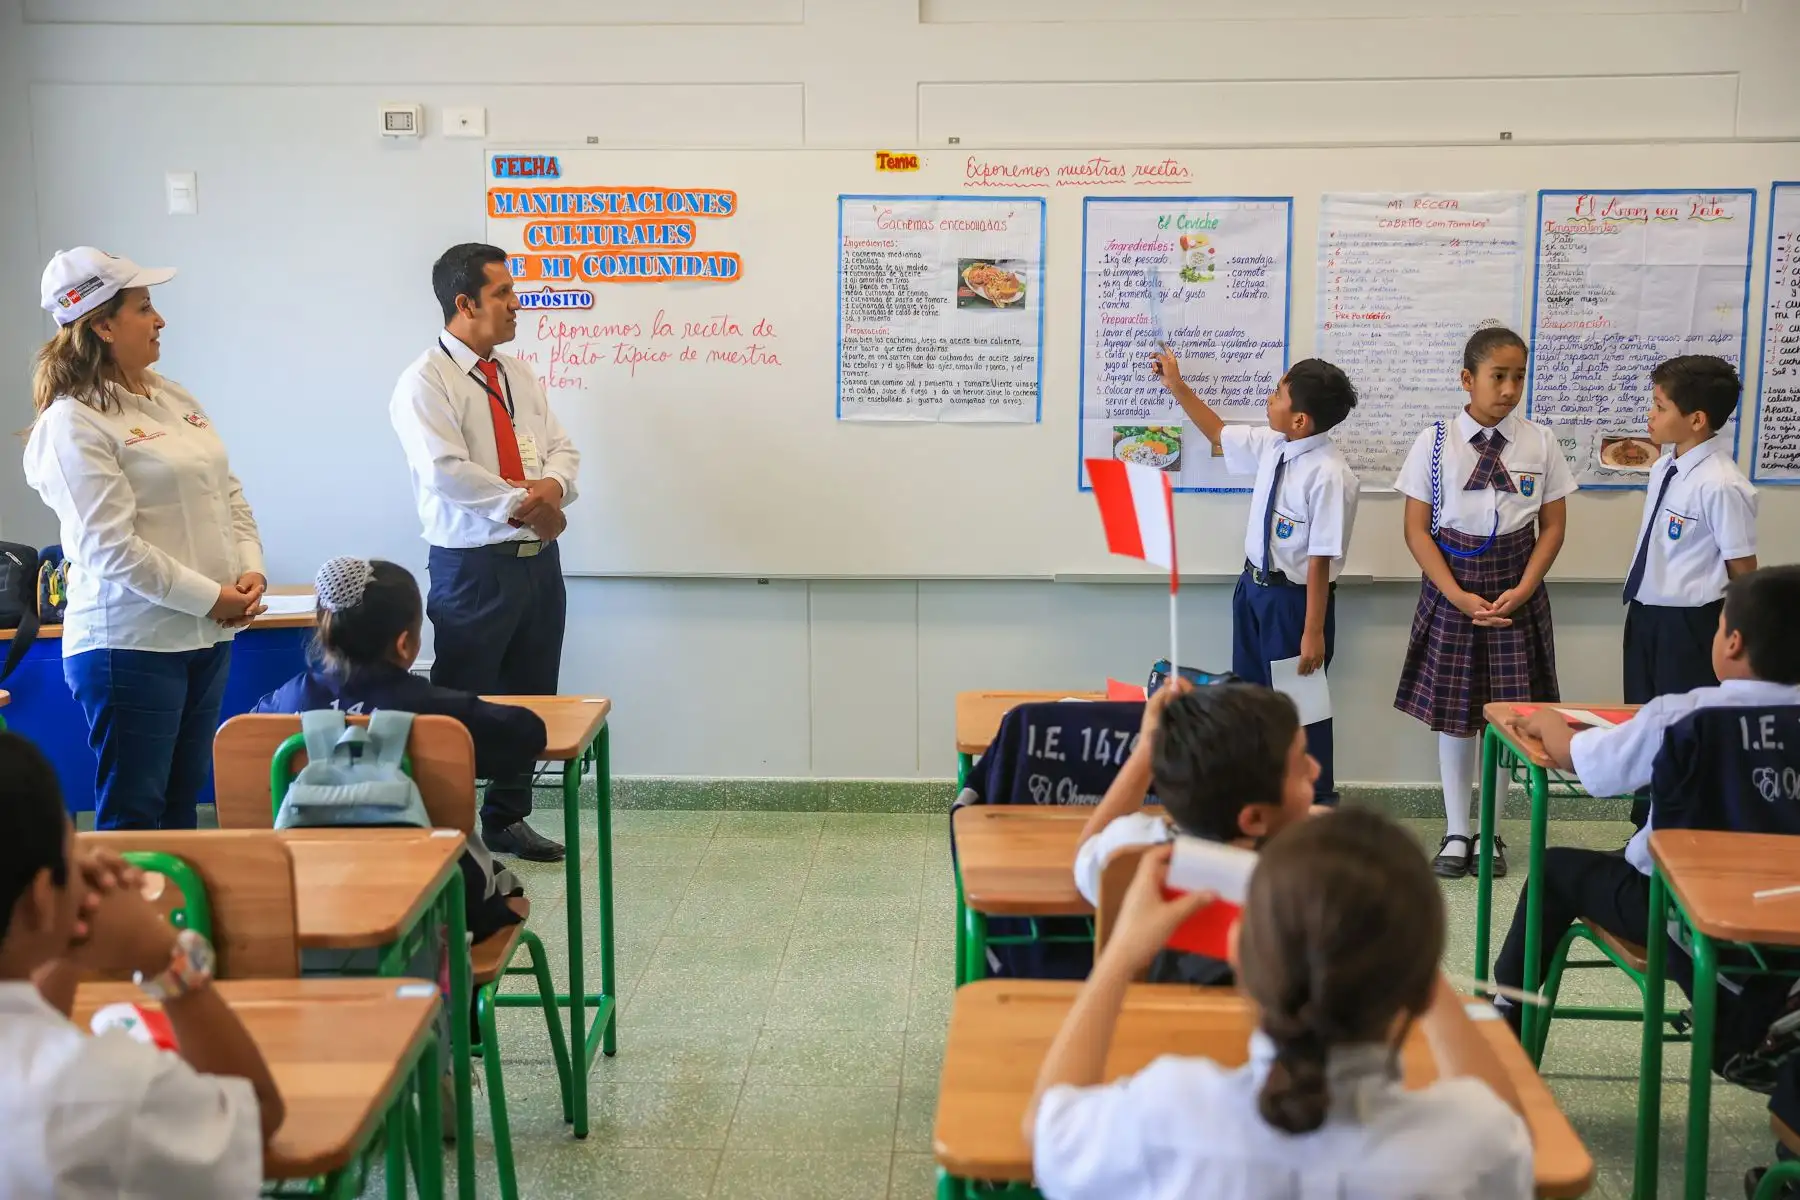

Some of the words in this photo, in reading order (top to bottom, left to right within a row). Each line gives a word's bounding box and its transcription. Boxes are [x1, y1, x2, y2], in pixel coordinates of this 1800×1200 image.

[494, 157, 560, 176] FECHA
[876, 152, 918, 169] Tema
[966, 156, 1050, 182] Exponemos
[1057, 157, 1126, 177] nuestras
[493, 191, 733, 215] MANIFESTACIONES
[1575, 194, 1596, 217] El
[1176, 212, 1219, 230] Ceviche
[528, 224, 693, 247] CULTURALES
[1104, 236, 1175, 255] Ingredientes:
[541, 257, 572, 278] MI
[582, 255, 737, 278] COMUNIDAD
[1121, 253, 1132, 264] de
[1124, 277, 1132, 287] de
[1172, 286, 1184, 299] al
[1184, 289, 1206, 303] gusto
[537, 315, 641, 353] Exponemos
[651, 309, 675, 341] la
[680, 316, 744, 340] receta
[752, 319, 777, 339] de
[1125, 327, 1133, 337] el
[1167, 330, 1173, 340] y
[1202, 329, 1213, 337] en
[1214, 326, 1245, 338] cuadros
[1103, 340, 1132, 352] Agregar
[1136, 339, 1147, 347] sal
[517, 348, 540, 364] un
[550, 342, 606, 379] plato
[612, 342, 676, 378] típico
[679, 346, 698, 362] de
[706, 343, 783, 366] nuestra
[1121, 359, 1129, 369] al
[1129, 351, 1134, 361] y
[1220, 350, 1254, 364] agregar
[1254, 349, 1266, 359] el
[1105, 372, 1133, 386] Agregar
[1134, 371, 1146, 382] las
[1213, 375, 1219, 386] y
[1221, 370, 1252, 382] mezclar
[1104, 385, 1132, 395] Colocar
[1134, 387, 1145, 395] en
[1220, 385, 1241, 399] hojas
[1242, 385, 1254, 396] de
[1130, 395, 1137, 405] el
[1168, 399, 1174, 410] y
[1207, 398, 1221, 407] con
[1105, 408, 1111, 419] y
[1027, 724, 1066, 762] I.E.
